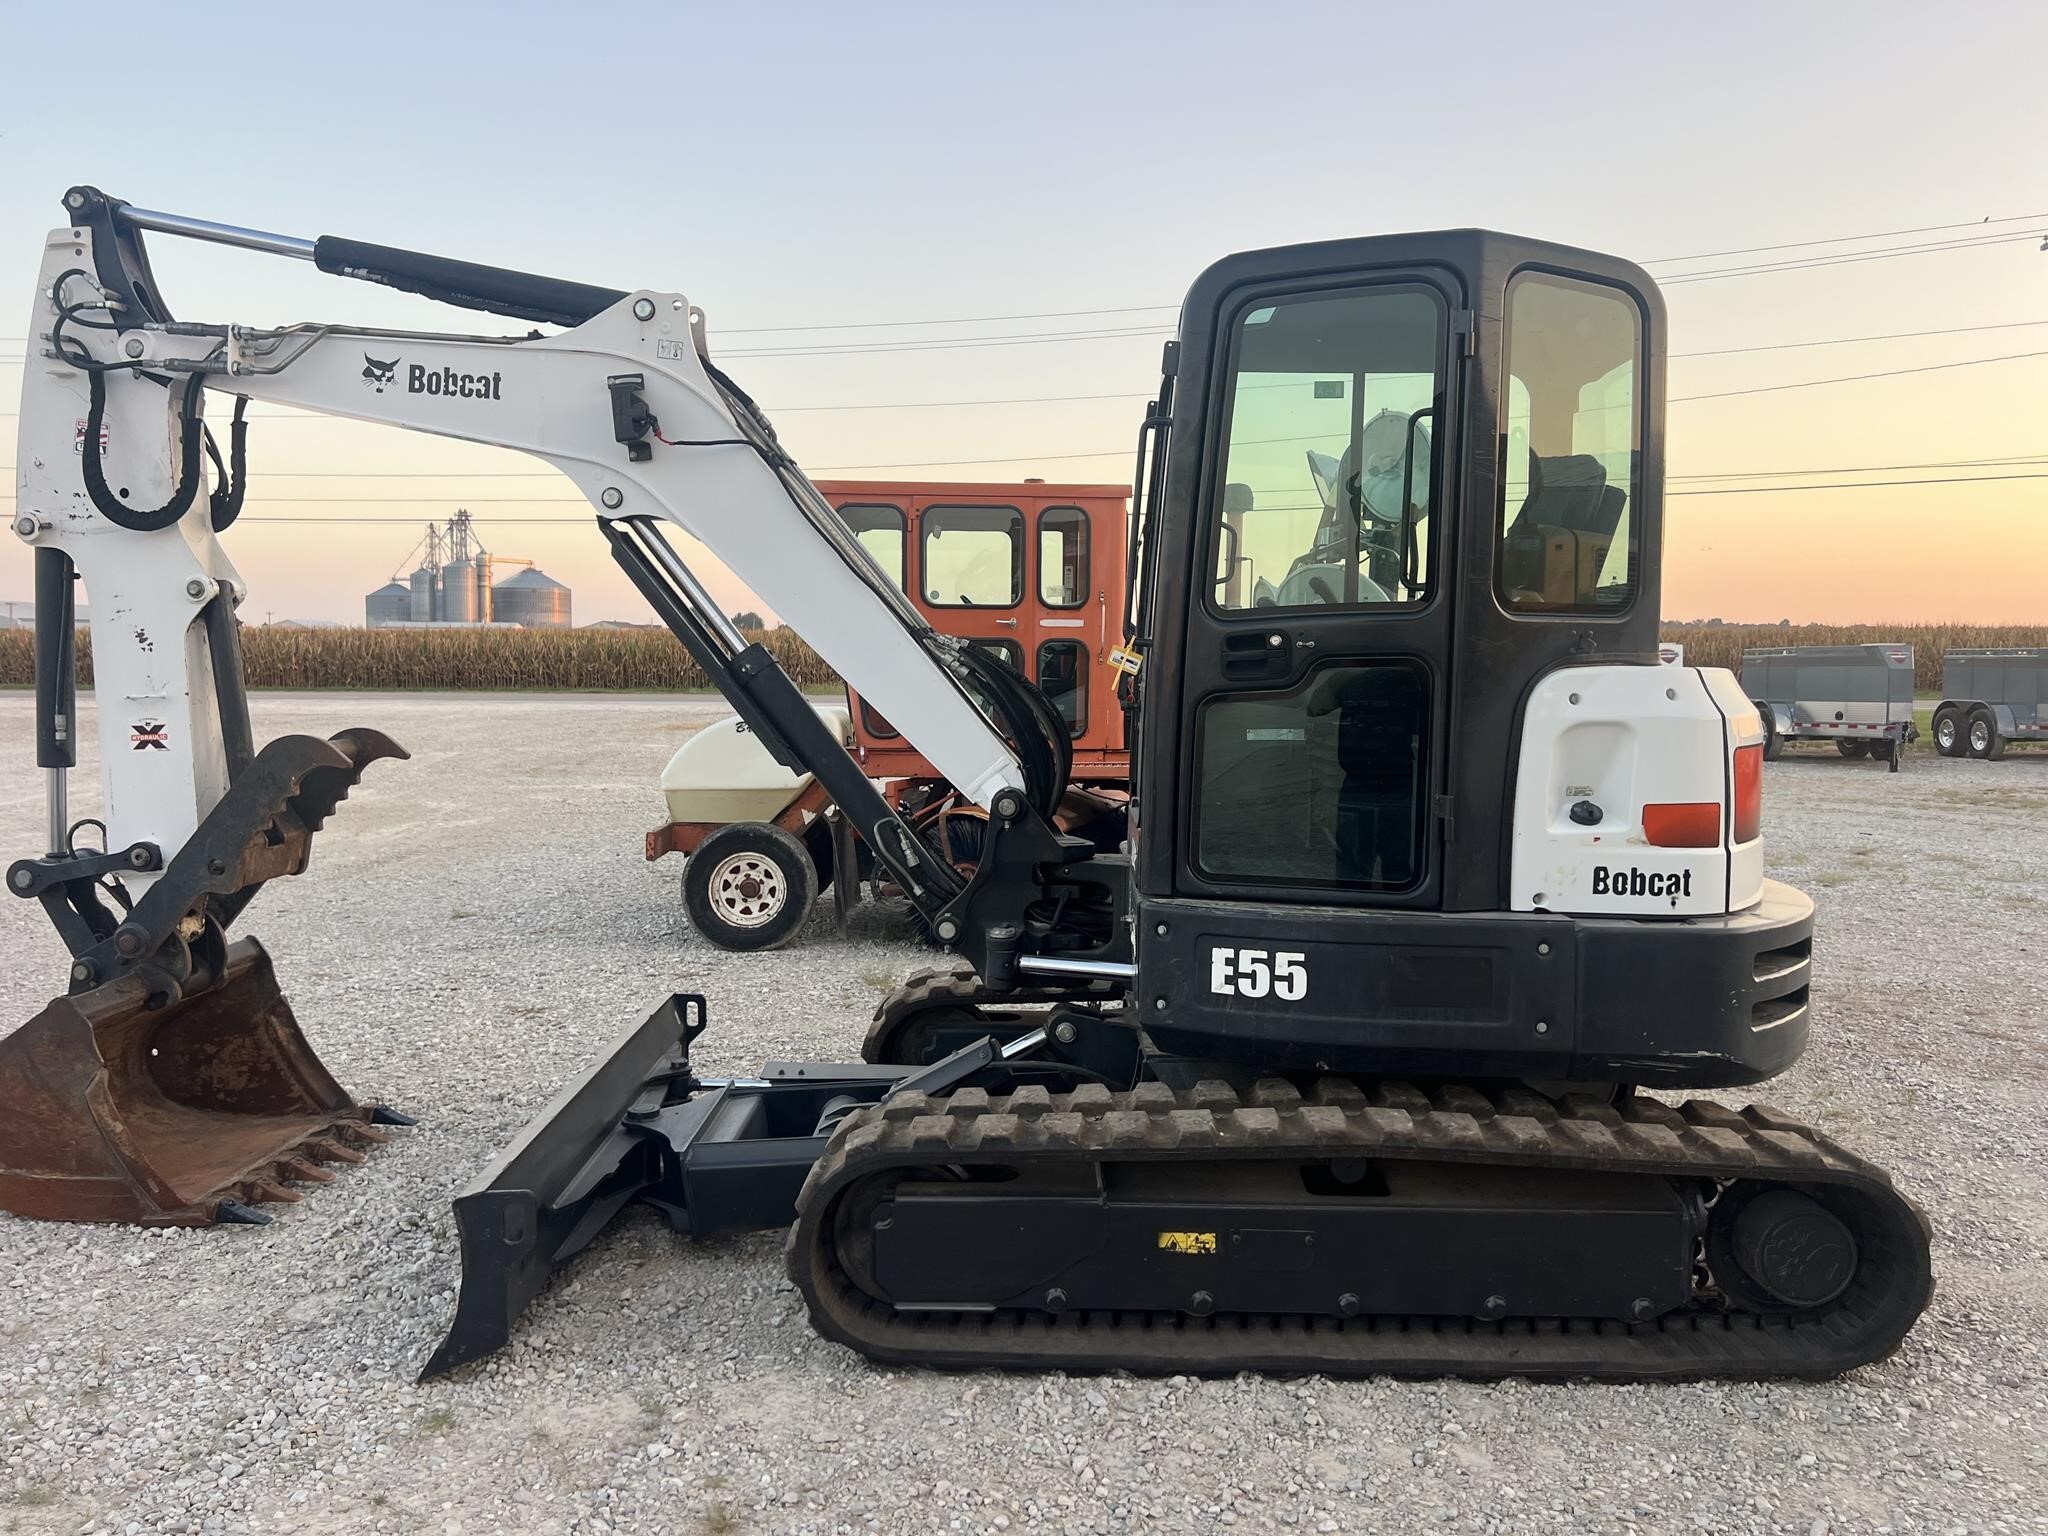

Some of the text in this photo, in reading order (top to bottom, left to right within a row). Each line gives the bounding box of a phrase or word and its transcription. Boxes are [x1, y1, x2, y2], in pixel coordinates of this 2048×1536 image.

[408, 364, 502, 400] Bobcat
[1592, 866, 1692, 897] Bobcat
[1211, 947, 1308, 1001] E55
